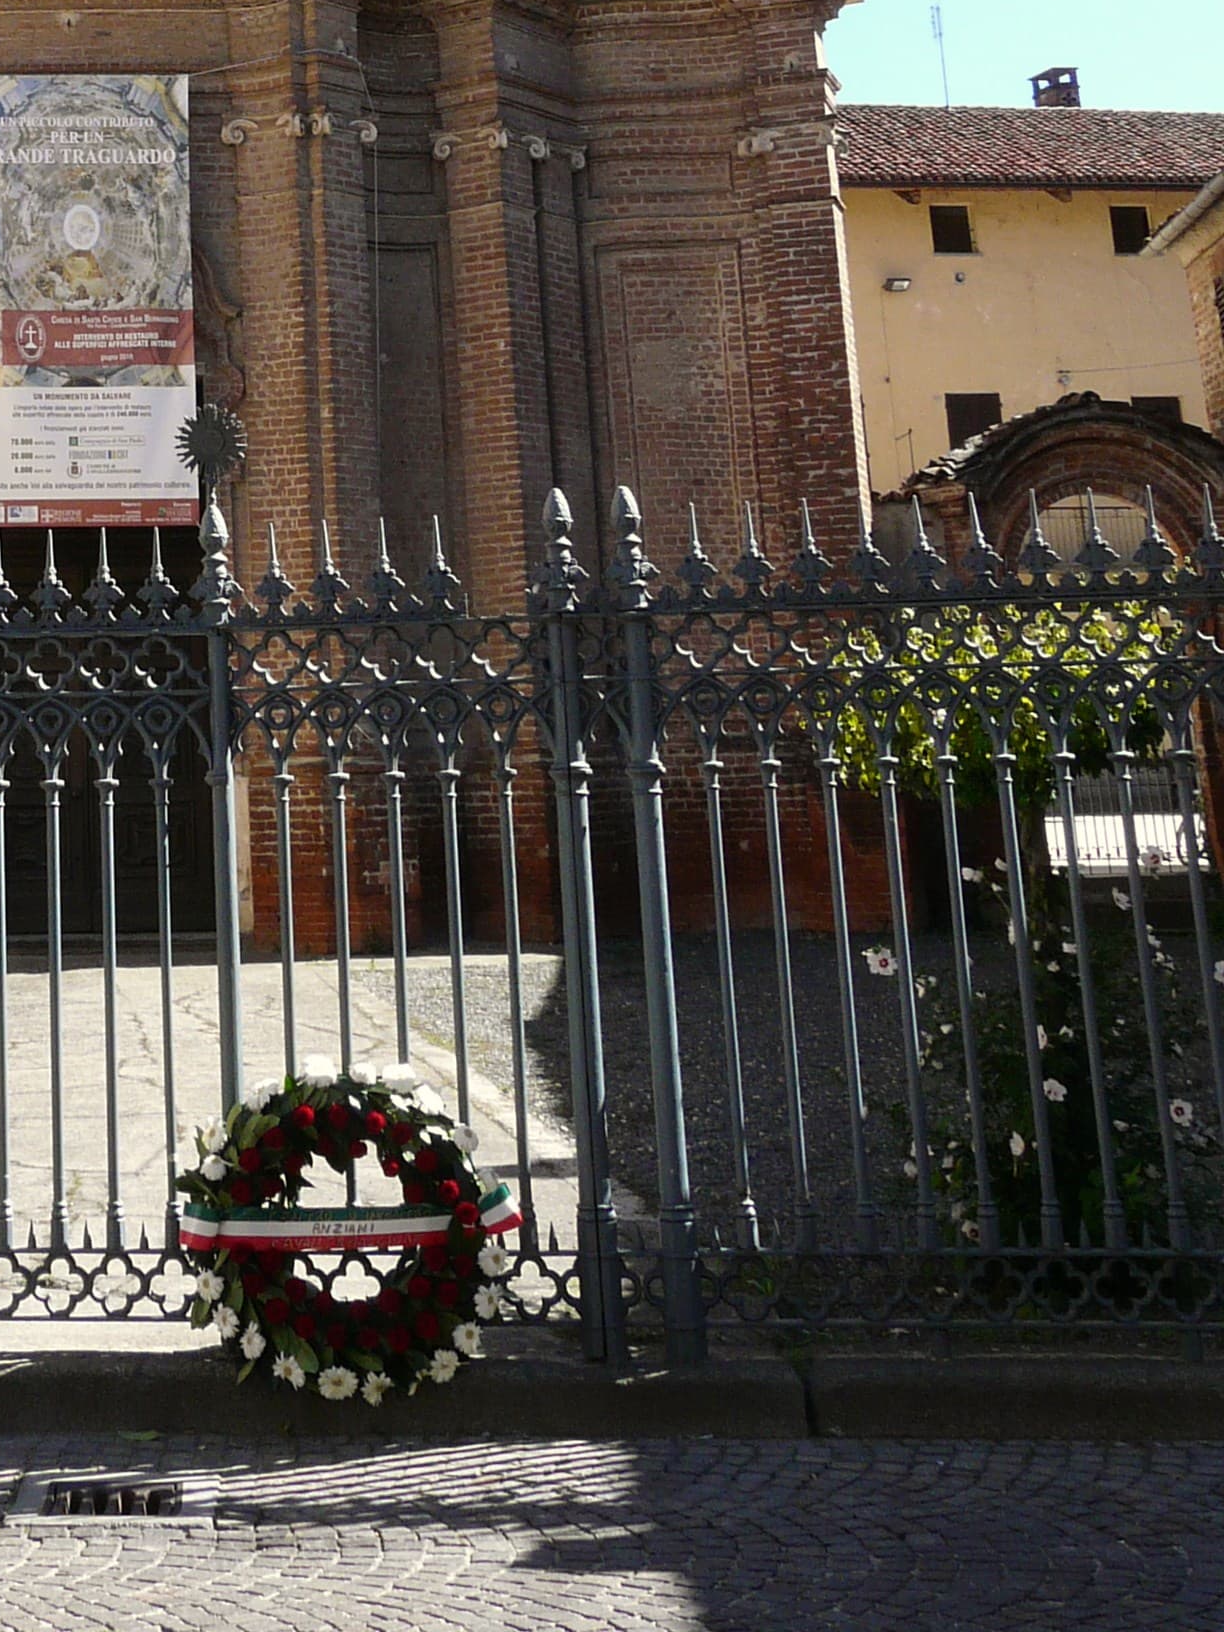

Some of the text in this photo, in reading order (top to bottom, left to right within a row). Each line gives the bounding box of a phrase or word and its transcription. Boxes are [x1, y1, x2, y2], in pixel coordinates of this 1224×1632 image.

[0, 117, 154, 127] UN PICCOLO CONTRIBUTO
[50, 131, 104, 144] PER UN
[60, 147, 177, 164] TRAGUARDO
[101, 392, 132, 400] SALVARE
[312, 1223, 375, 1235] ANZIANI
